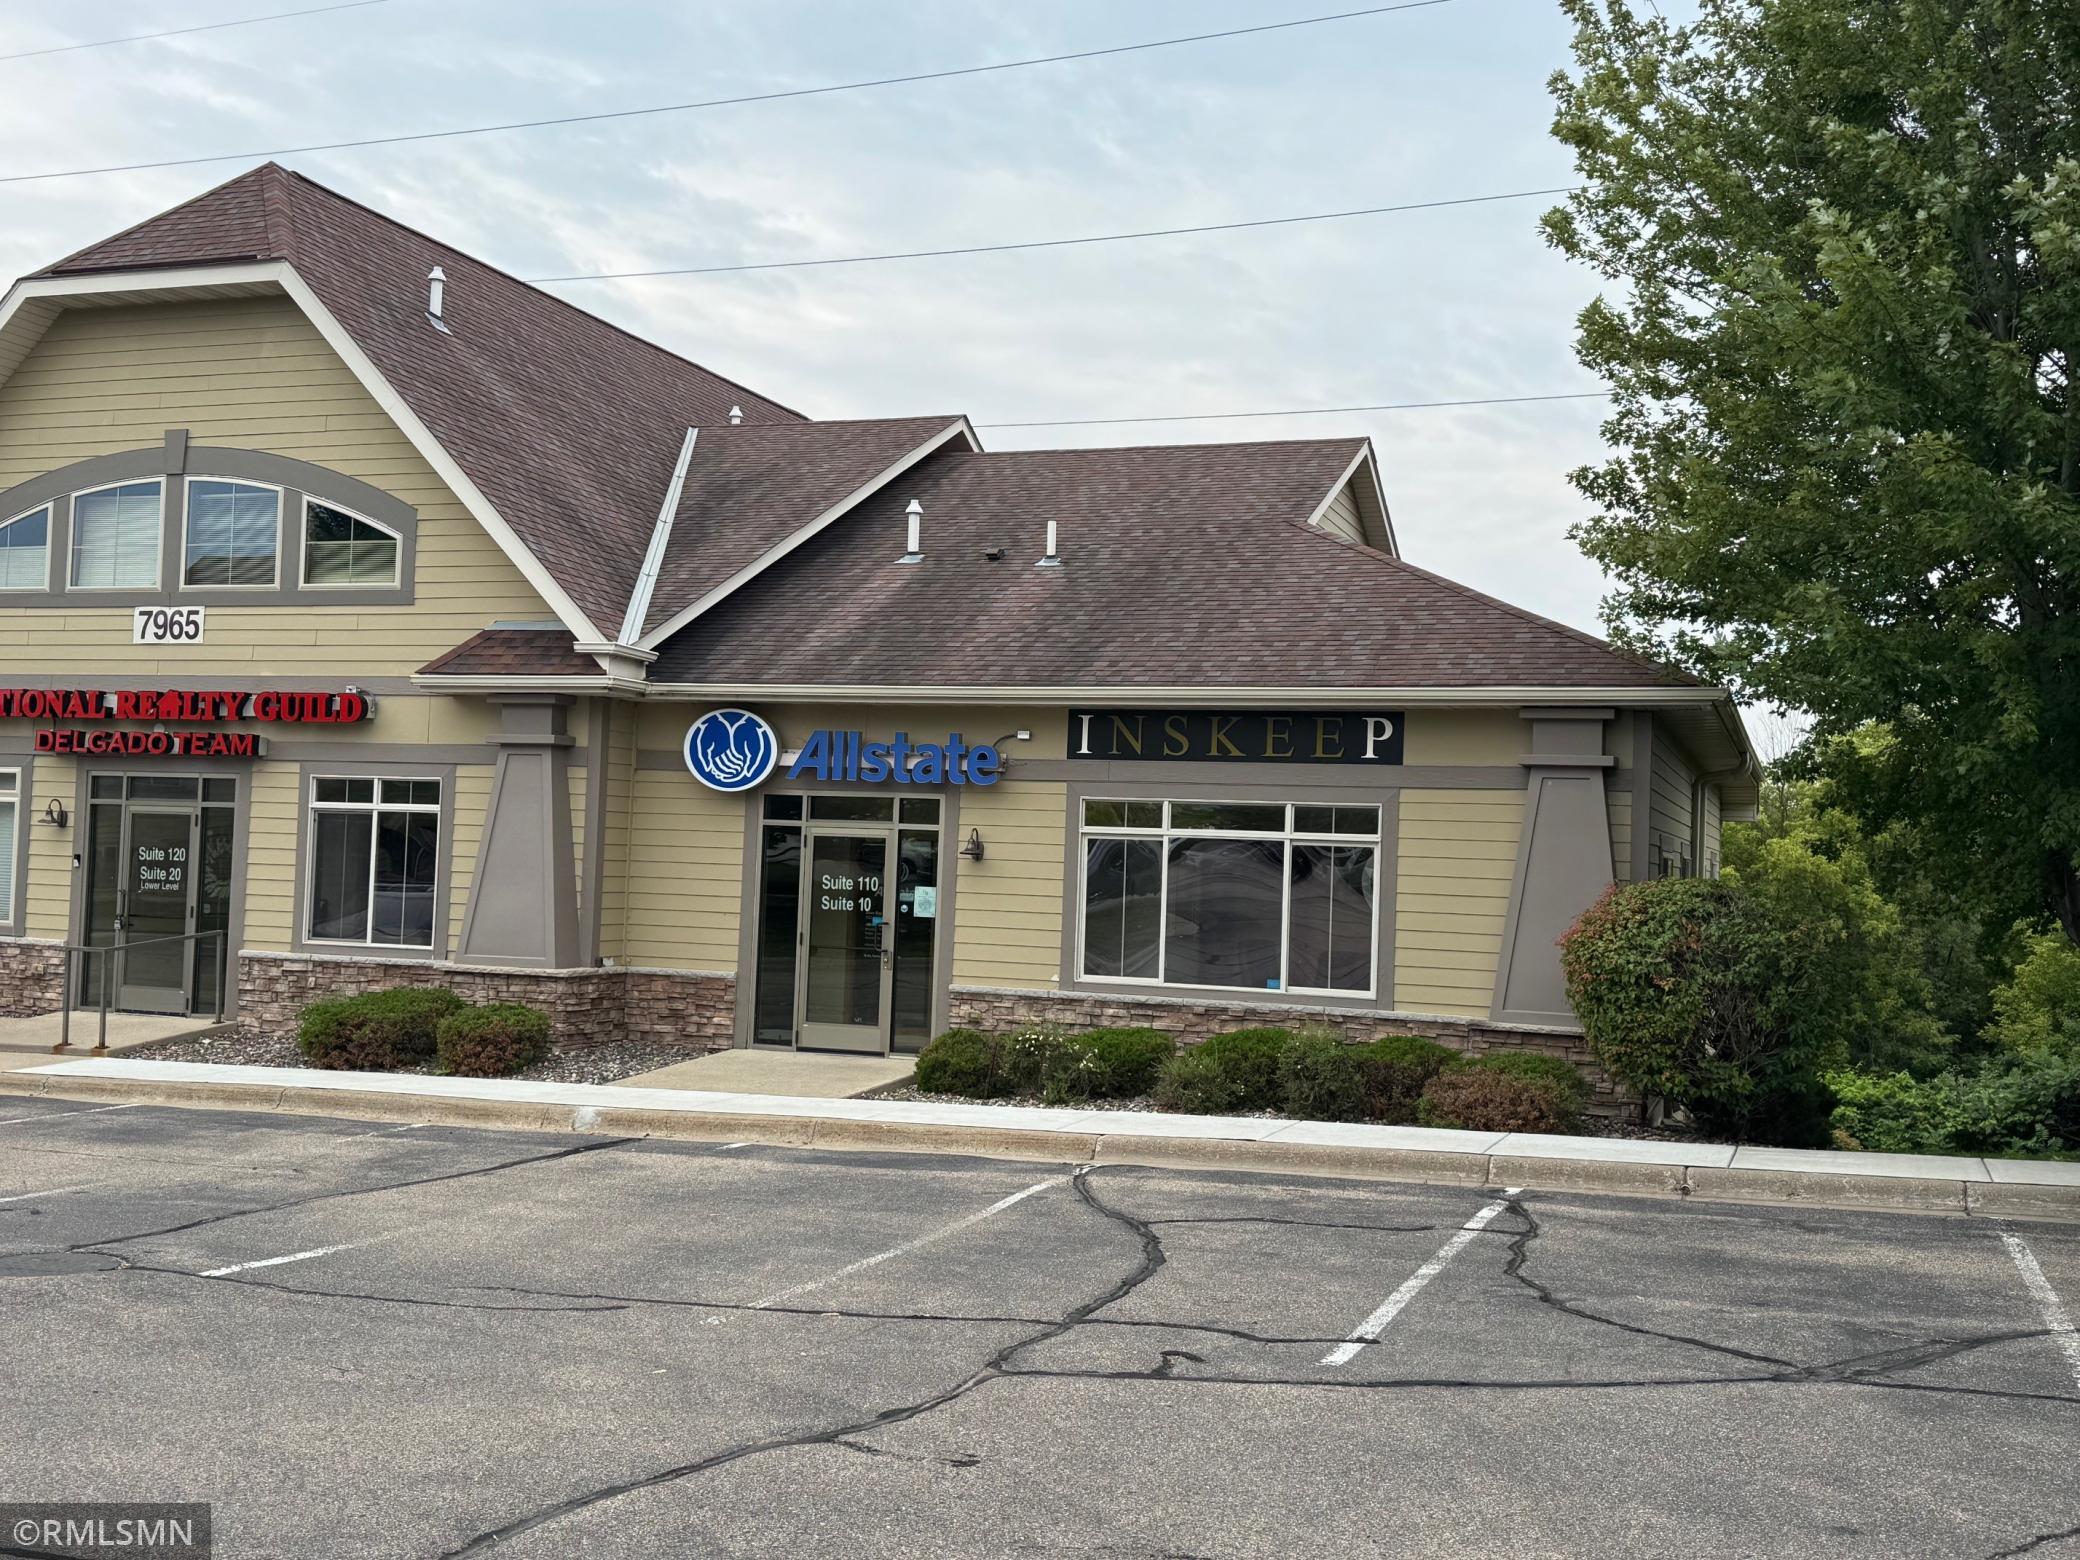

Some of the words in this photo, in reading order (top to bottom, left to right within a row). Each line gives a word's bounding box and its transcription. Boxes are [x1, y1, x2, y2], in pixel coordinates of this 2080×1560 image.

[138, 608, 200, 640] 7965
[253, 691, 363, 723] GUILD
[35, 730, 168, 754] DELGADO
[173, 732, 256, 756] TEAM
[1076, 714, 1393, 759] INSKEEP
[786, 729, 1000, 786] Allstate
[138, 847, 165, 860] Suite
[168, 848, 186, 861] 120
[140, 866, 166, 880] Suite
[169, 867, 181, 881] 20
[822, 875, 854, 891] Suite
[858, 876, 879, 892] 110
[140, 881, 160, 890] Lower
[162, 881, 179, 890] Level
[821, 896, 854, 911] Suite
[858, 897, 872, 912] 10
